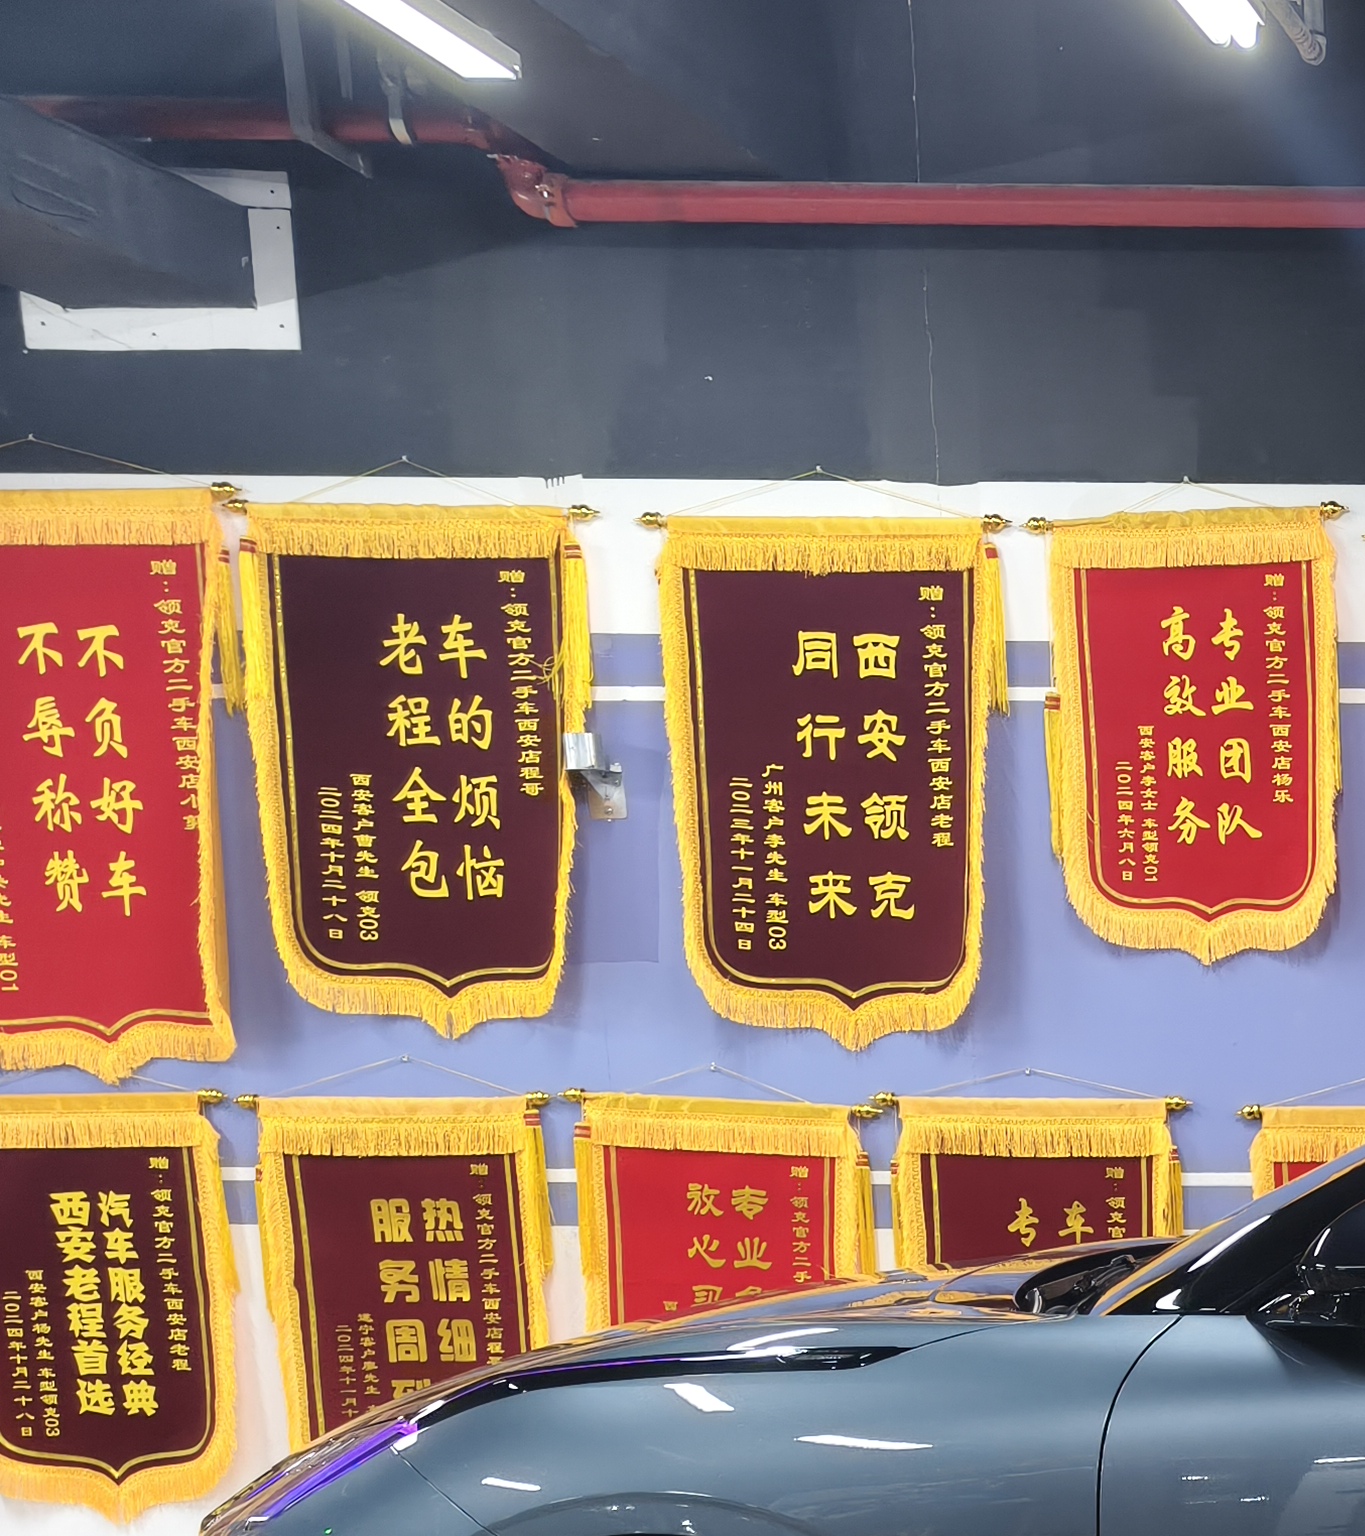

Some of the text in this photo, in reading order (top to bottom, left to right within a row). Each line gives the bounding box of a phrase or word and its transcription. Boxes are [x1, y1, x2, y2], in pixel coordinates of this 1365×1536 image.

[17, 621, 90, 913] 不辱称赞
[77, 623, 147, 917] 不负好车
[379, 613, 450, 899] 老程全包
[437, 614, 505, 901] 车的烦恼
[498, 569, 545, 797] 赠：领克官方二手车西安店程哥
[792, 630, 857, 919] 同行未来
[852, 633, 915, 921] 西安领克
[918, 585, 954, 848] 赠：领克官方二手车西安店老程
[1137, 725, 1158, 811] 西安客户李女士
[1160, 606, 1211, 845] 高效服务
[1211, 608, 1263, 845] 专业团队
[1263, 574, 1294, 804] 赠：领克官方二手车西安店杨乐
[350, 773, 379, 880] 西安客户曹先生
[762, 763, 789, 951] 广州客户李先生 车型03
[49, 1190, 116, 1417] 西安老程首选
[98, 1190, 159, 1418] 汽车服务经典
[148, 1156, 192, 1372] 赠：领克官方二手车西安店老程
[1007, 1197, 1041, 1248] 专
[1058, 1199, 1094, 1244] 车
